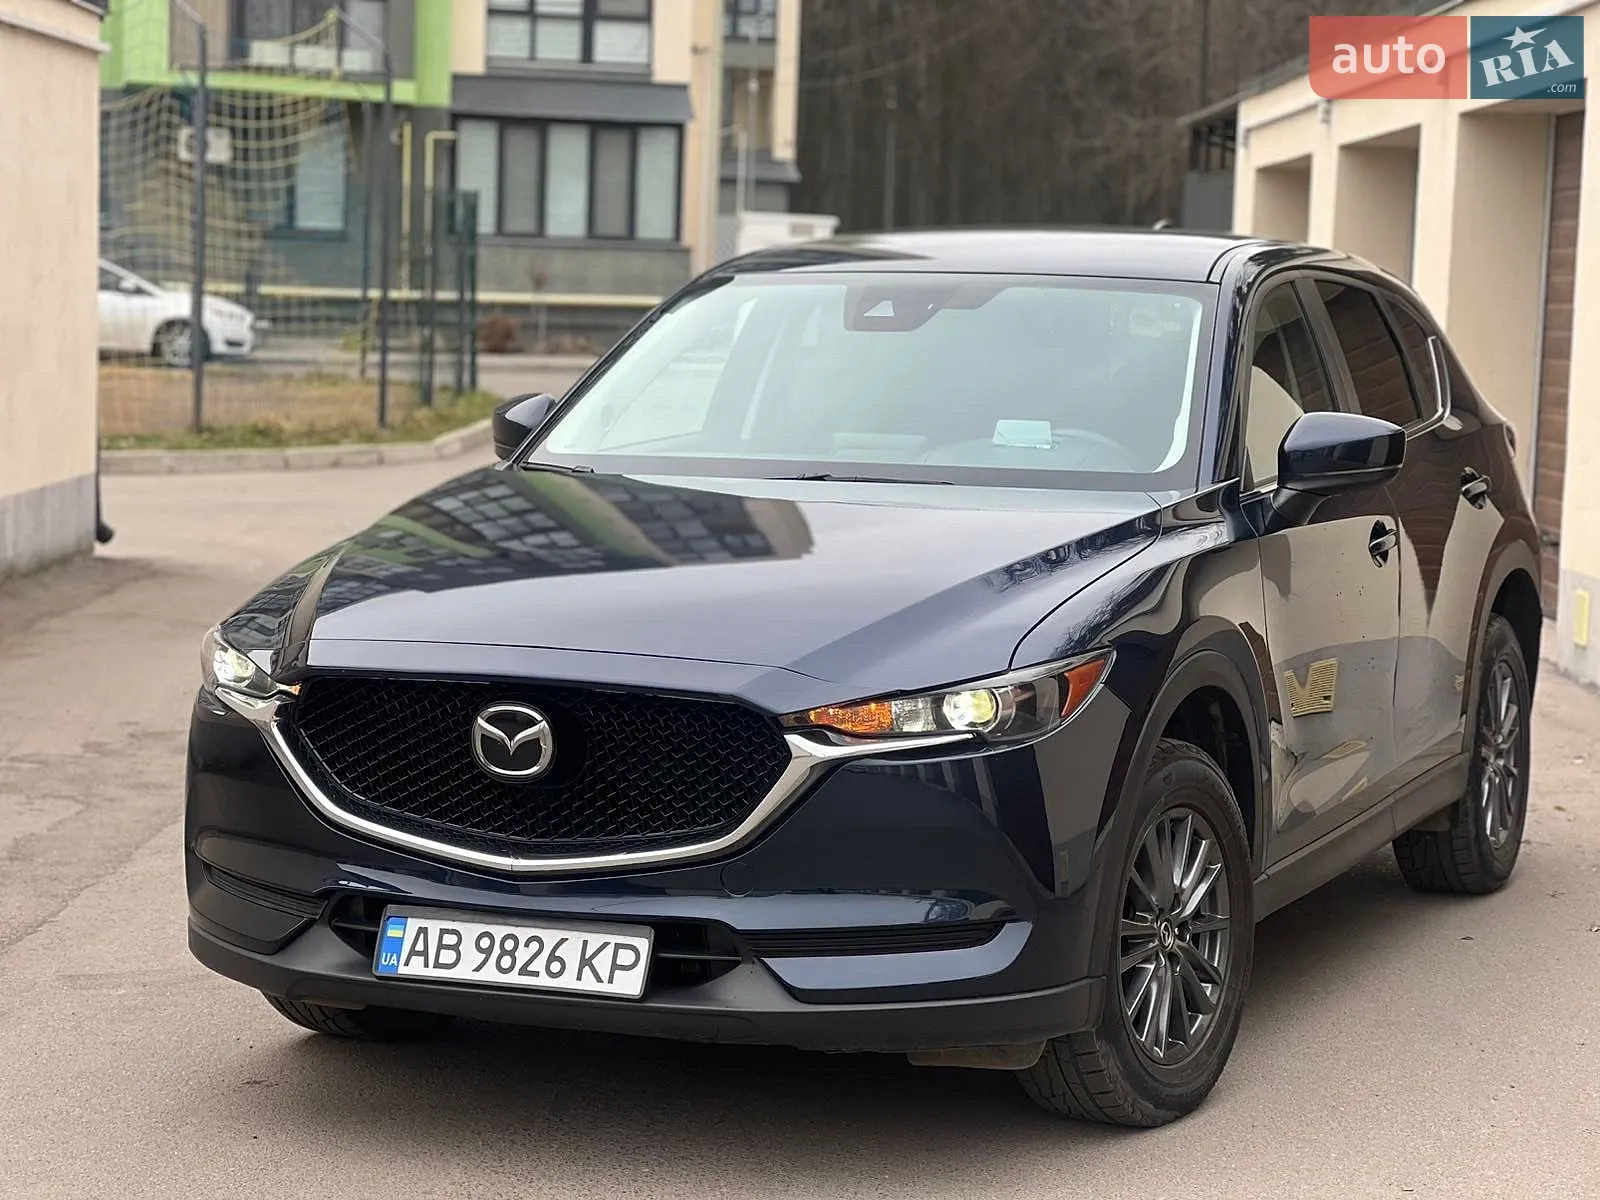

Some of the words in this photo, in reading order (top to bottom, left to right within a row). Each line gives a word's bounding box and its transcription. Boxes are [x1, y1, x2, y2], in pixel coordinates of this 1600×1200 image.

[381, 952, 398, 967] UA
[403, 926, 463, 970] AB
[471, 931, 569, 979] 9826
[575, 939, 641, 984] KP
